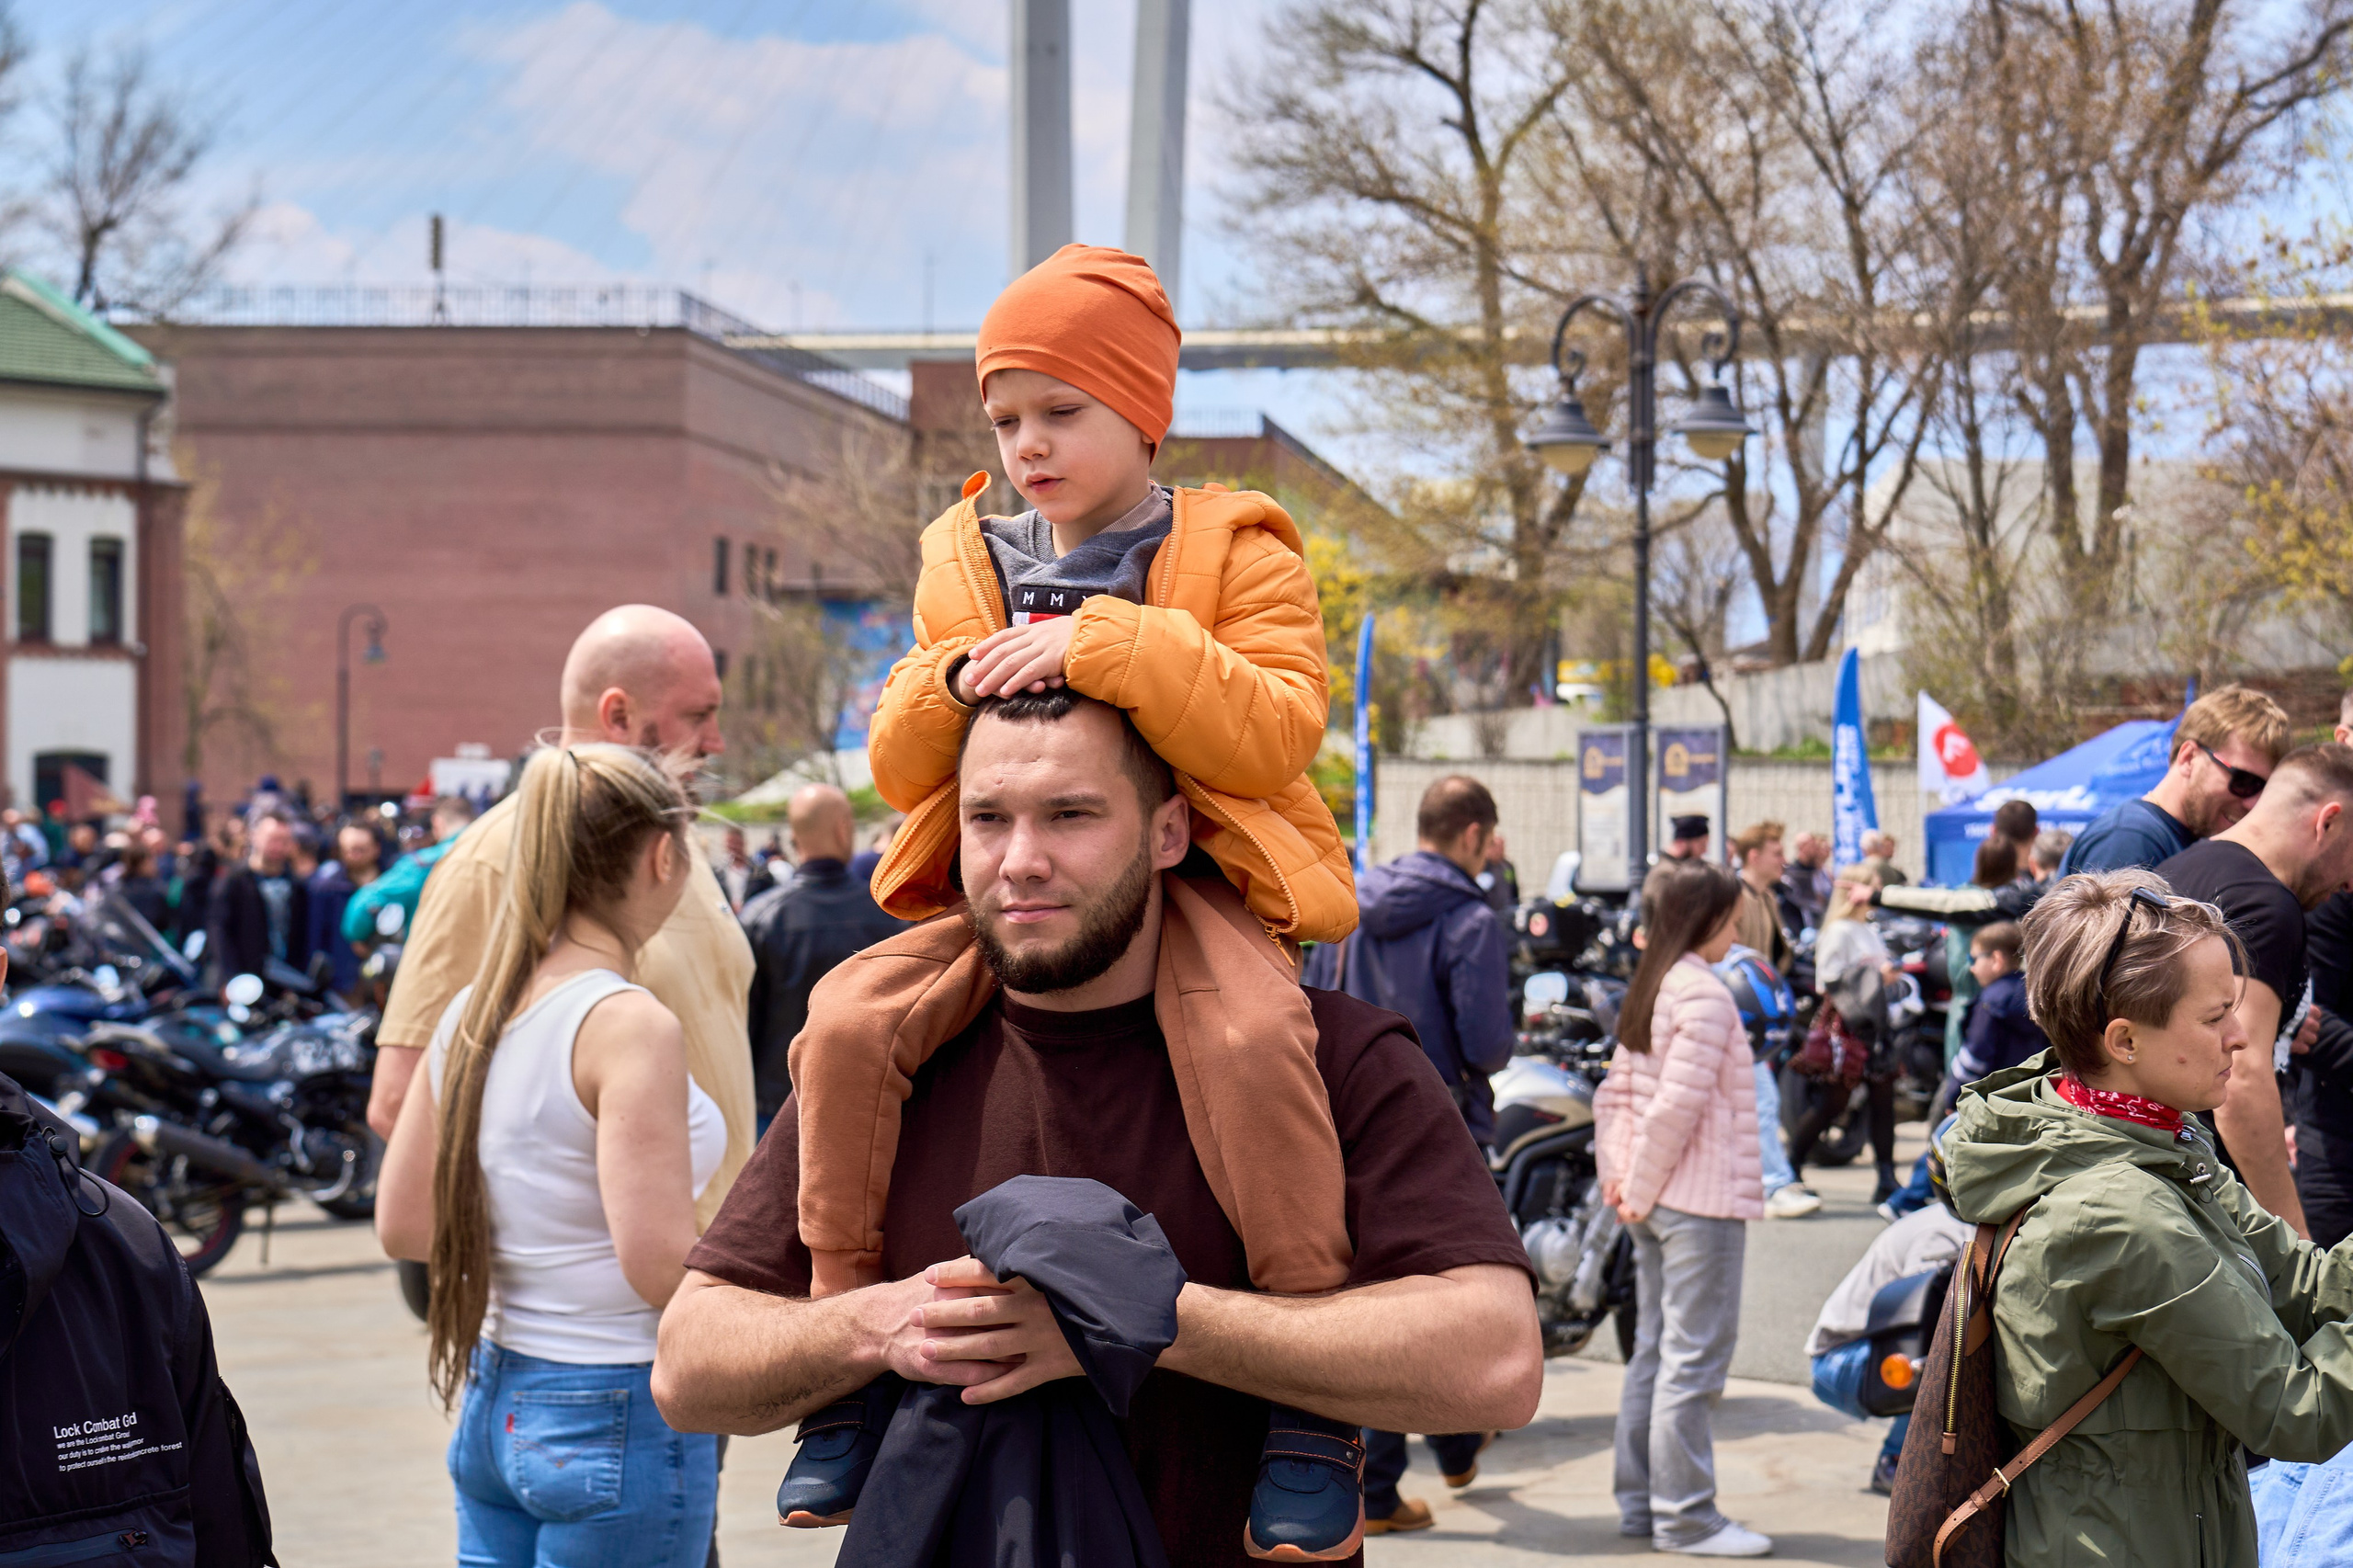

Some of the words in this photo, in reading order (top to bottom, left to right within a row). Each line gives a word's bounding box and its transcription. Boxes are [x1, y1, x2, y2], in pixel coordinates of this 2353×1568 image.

[53, 1423, 81, 1439] Lock
[83, 1417, 120, 1434] Combat
[56, 1441, 65, 1449] we
[58, 1452, 68, 1460] our
[69, 1449, 81, 1460] duty
[59, 1463, 66, 1471] to
[160, 1441, 183, 1452] forest
